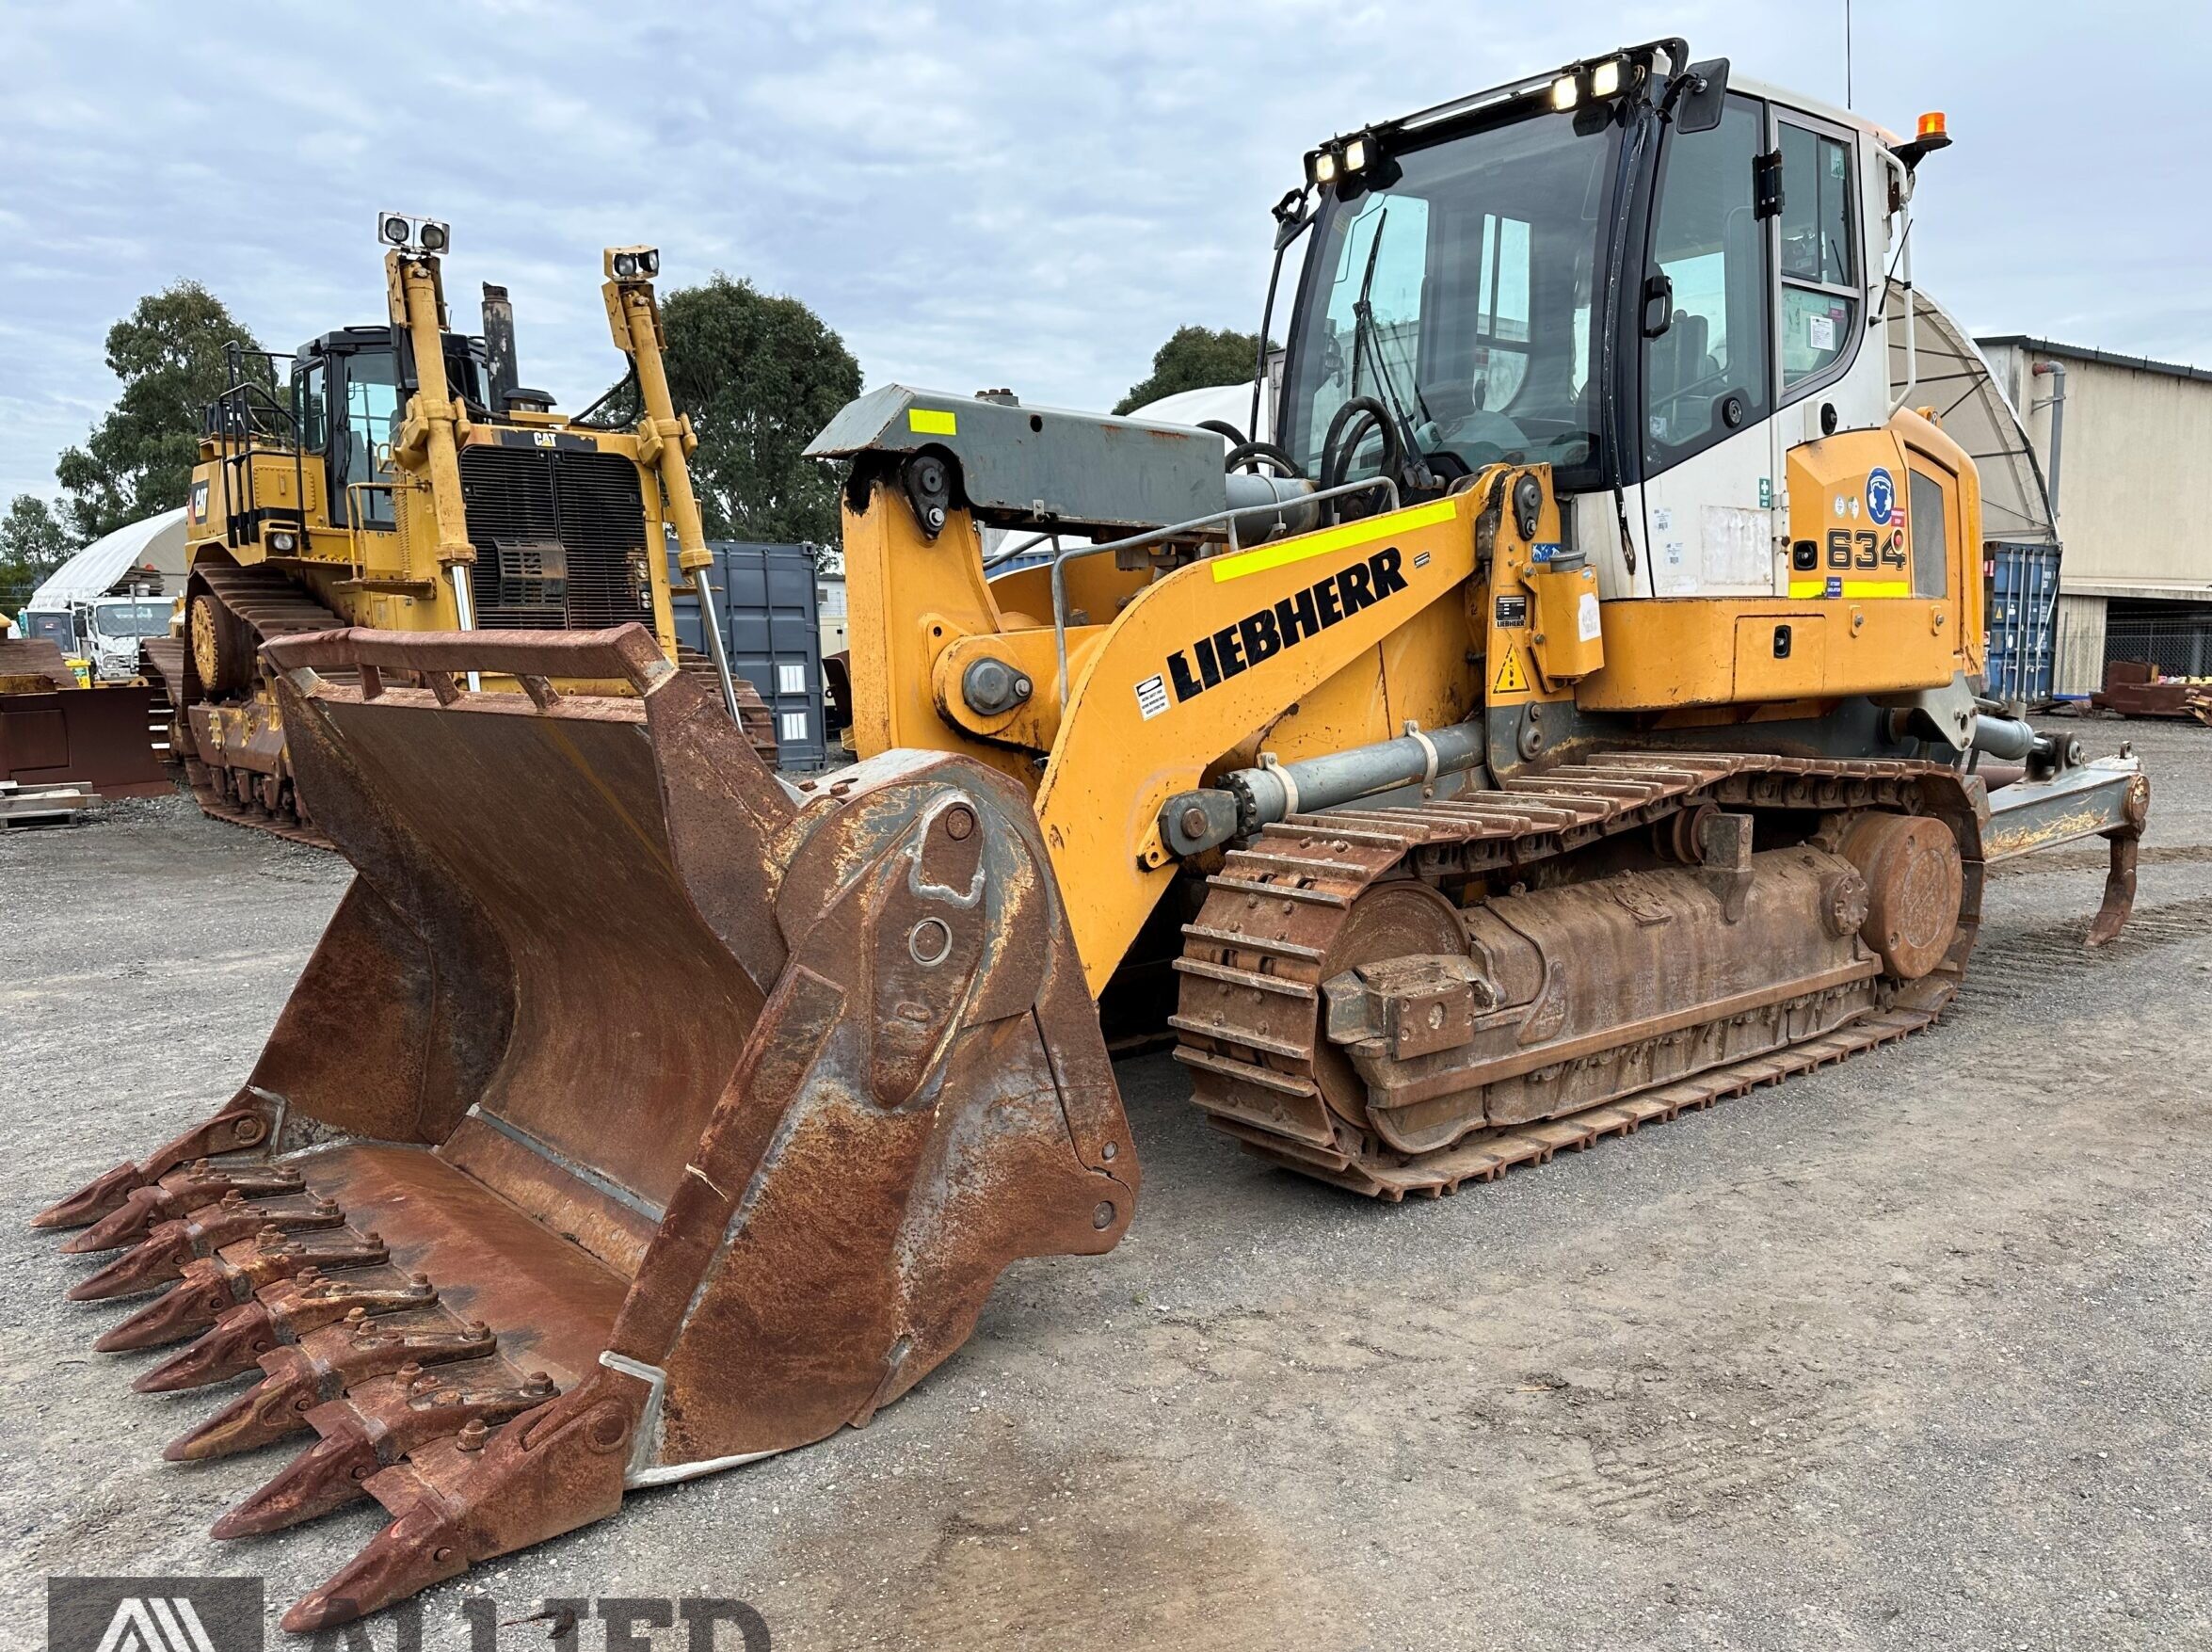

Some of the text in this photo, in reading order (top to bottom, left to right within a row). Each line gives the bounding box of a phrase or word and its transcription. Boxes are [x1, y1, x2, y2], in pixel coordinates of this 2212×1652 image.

[533, 432, 556, 447] CAT
[195, 487, 208, 517] CAT
[1828, 528, 1906, 570] 634
[1166, 546, 1408, 703] LIEBHERR
[1497, 619, 1525, 628] LIEBHERR
